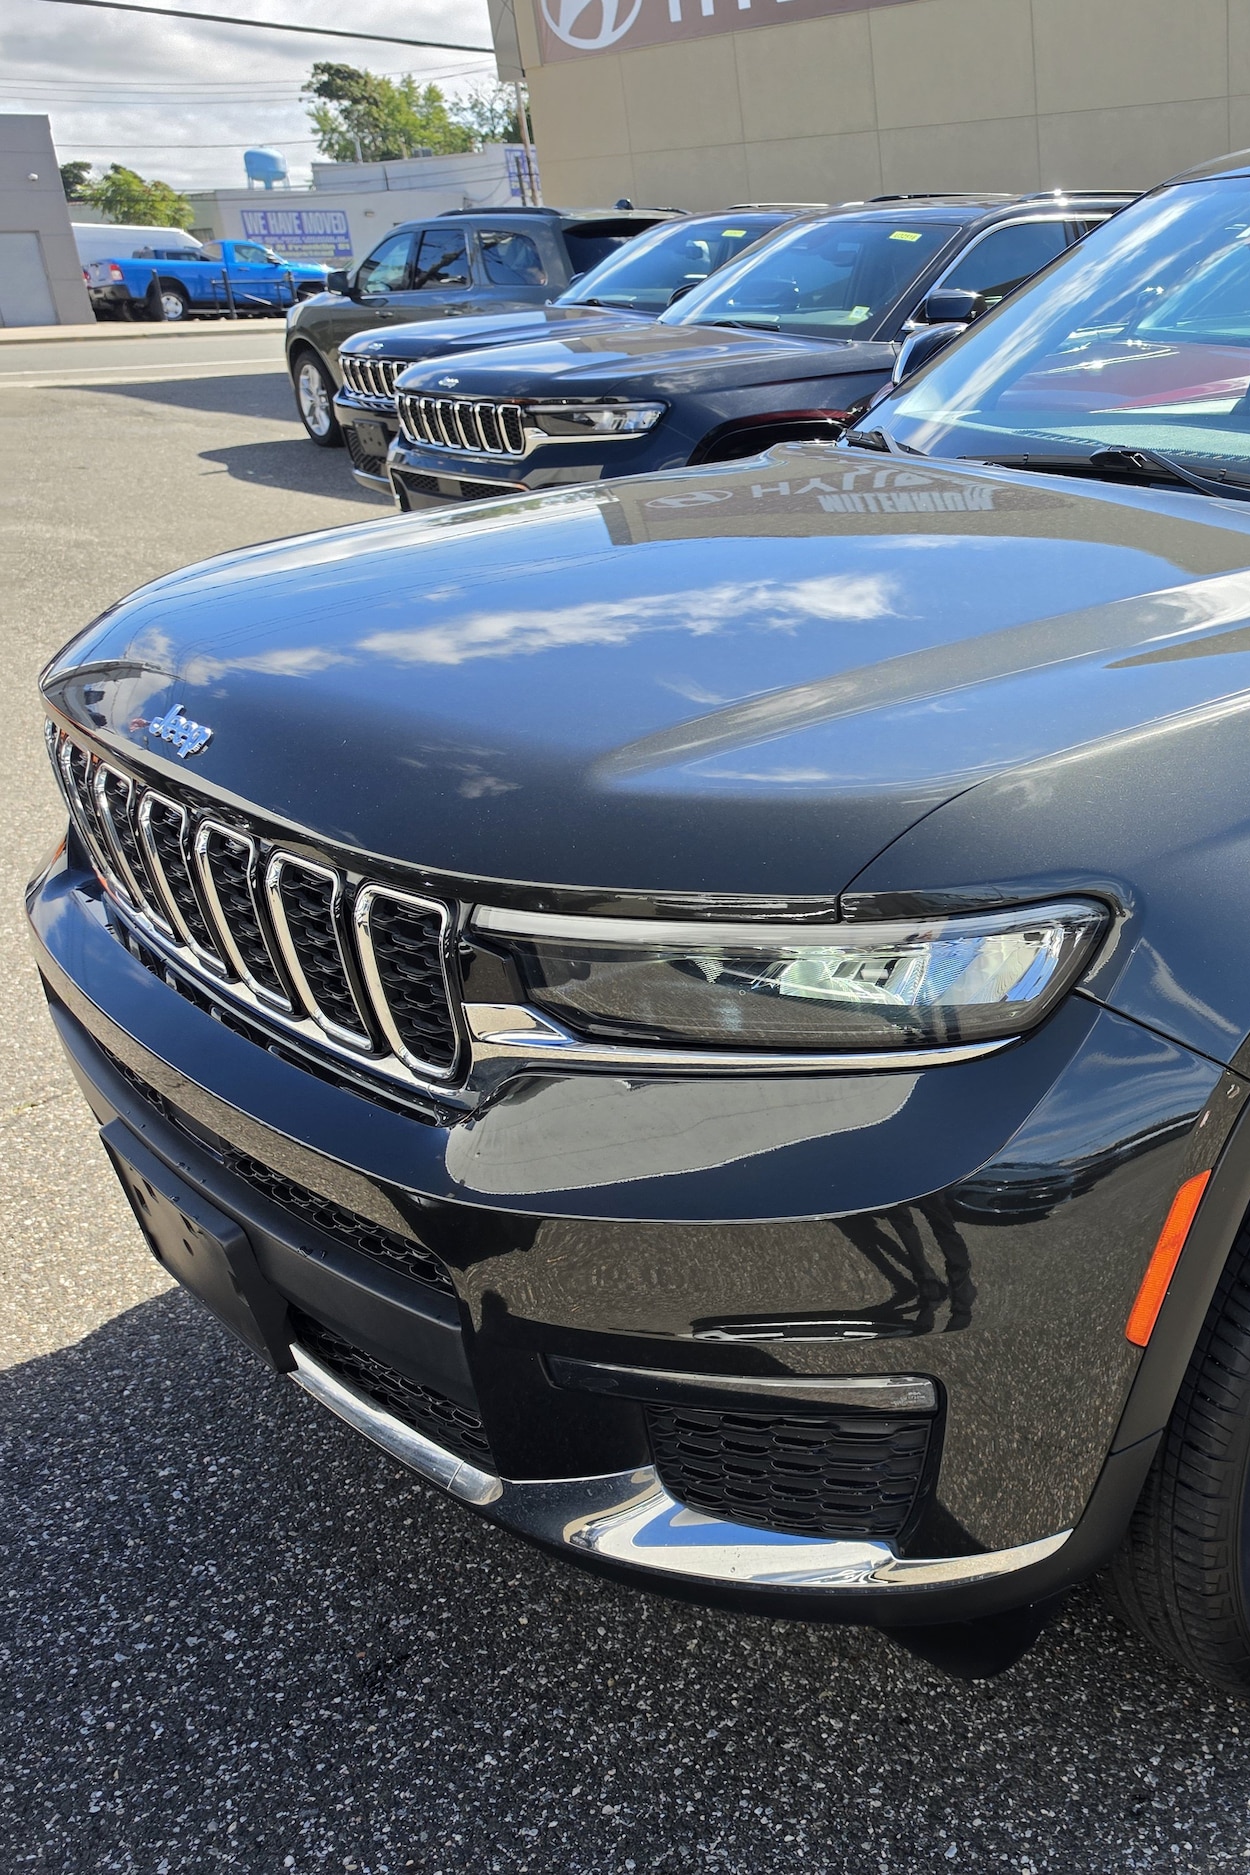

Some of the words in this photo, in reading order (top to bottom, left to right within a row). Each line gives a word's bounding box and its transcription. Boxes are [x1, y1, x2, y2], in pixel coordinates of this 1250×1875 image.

[242, 212, 268, 235] WE
[266, 212, 303, 235] HAVE
[301, 212, 347, 235] MOVED
[148, 703, 213, 759] Jeep
